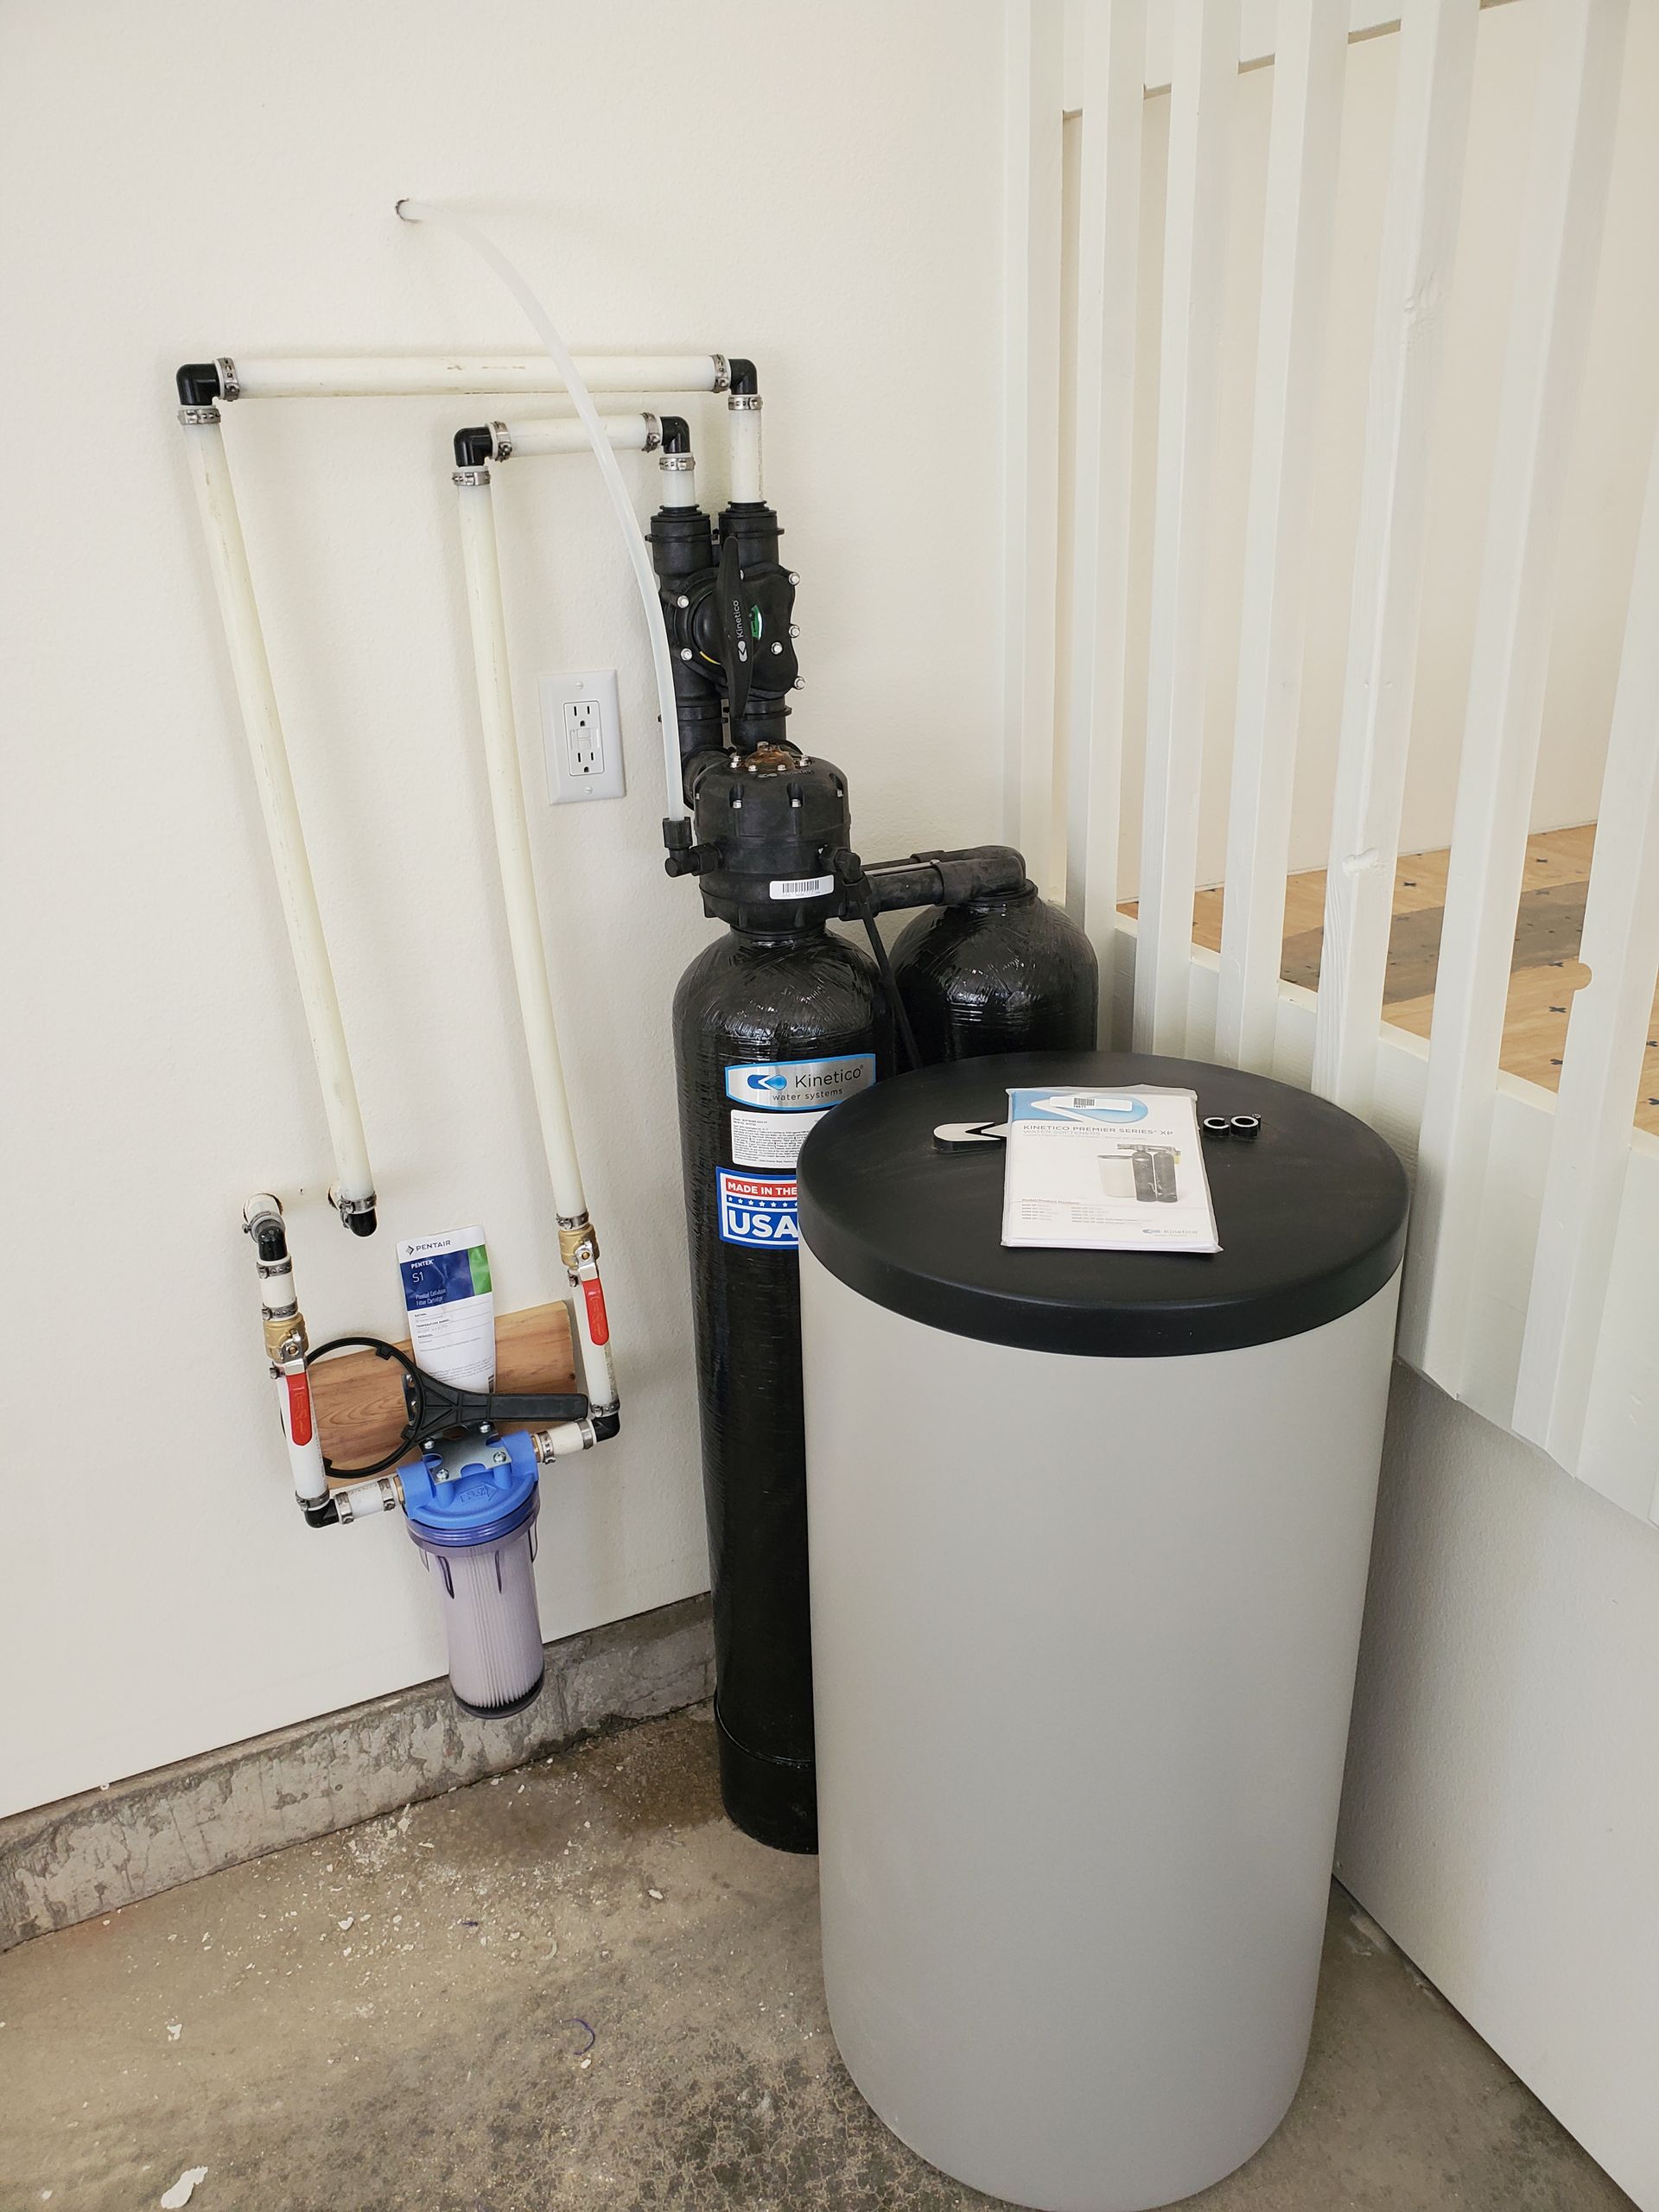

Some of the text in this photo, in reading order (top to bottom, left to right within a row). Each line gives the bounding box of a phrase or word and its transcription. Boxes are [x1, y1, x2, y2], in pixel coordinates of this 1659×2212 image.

[733, 600, 744, 639] Kinetico
[795, 1068, 861, 1089] Kinetico
[804, 1089, 842, 1100] systems
[728, 1181, 798, 1196] MADE IN THE
[728, 1209, 798, 1238] USA
[416, 1240, 451, 1251] PENTAIR
[412, 1271, 424, 1283] S1
